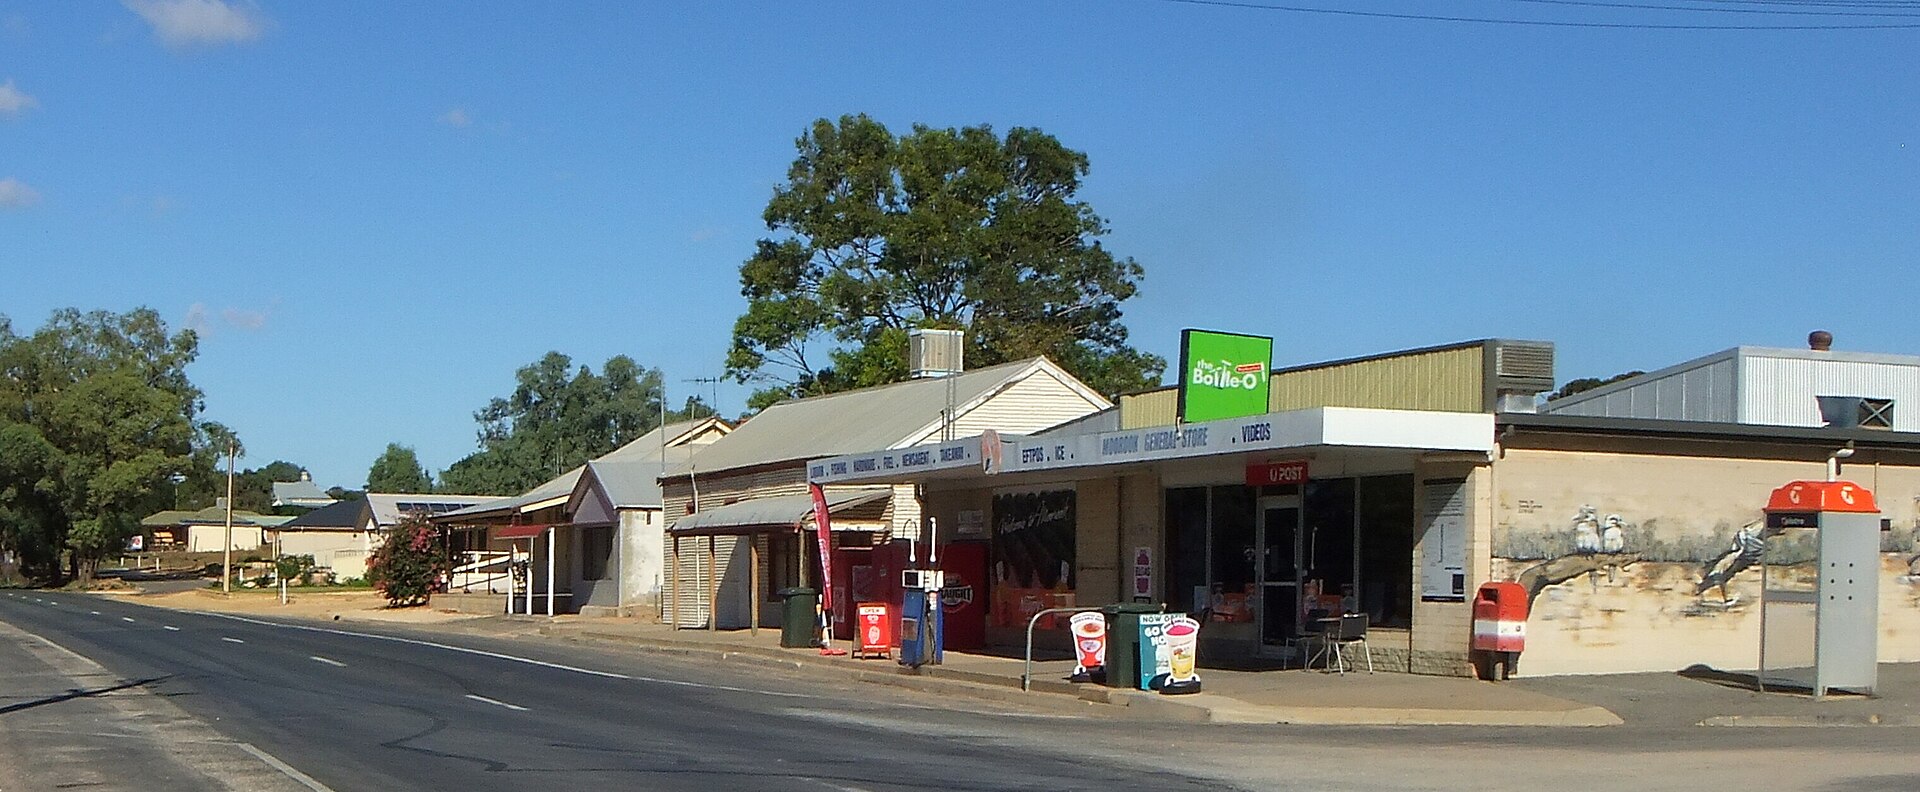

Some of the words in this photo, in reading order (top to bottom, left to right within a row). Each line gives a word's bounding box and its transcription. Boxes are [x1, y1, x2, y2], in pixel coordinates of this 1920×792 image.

[1196, 359, 1214, 370] the
[1022, 446, 1044, 463] EFTPOS
[1055, 445, 1065, 460] ICE
[1102, 435, 1139, 456] MOOROOK
[1144, 430, 1177, 451] GENERAL
[1182, 427, 1209, 448] STORE
[1241, 422, 1271, 443] VIDEOS
[902, 451, 930, 467] NEWSAGENT
[1279, 466, 1303, 480] POST
[1142, 614, 1162, 624] NOW
